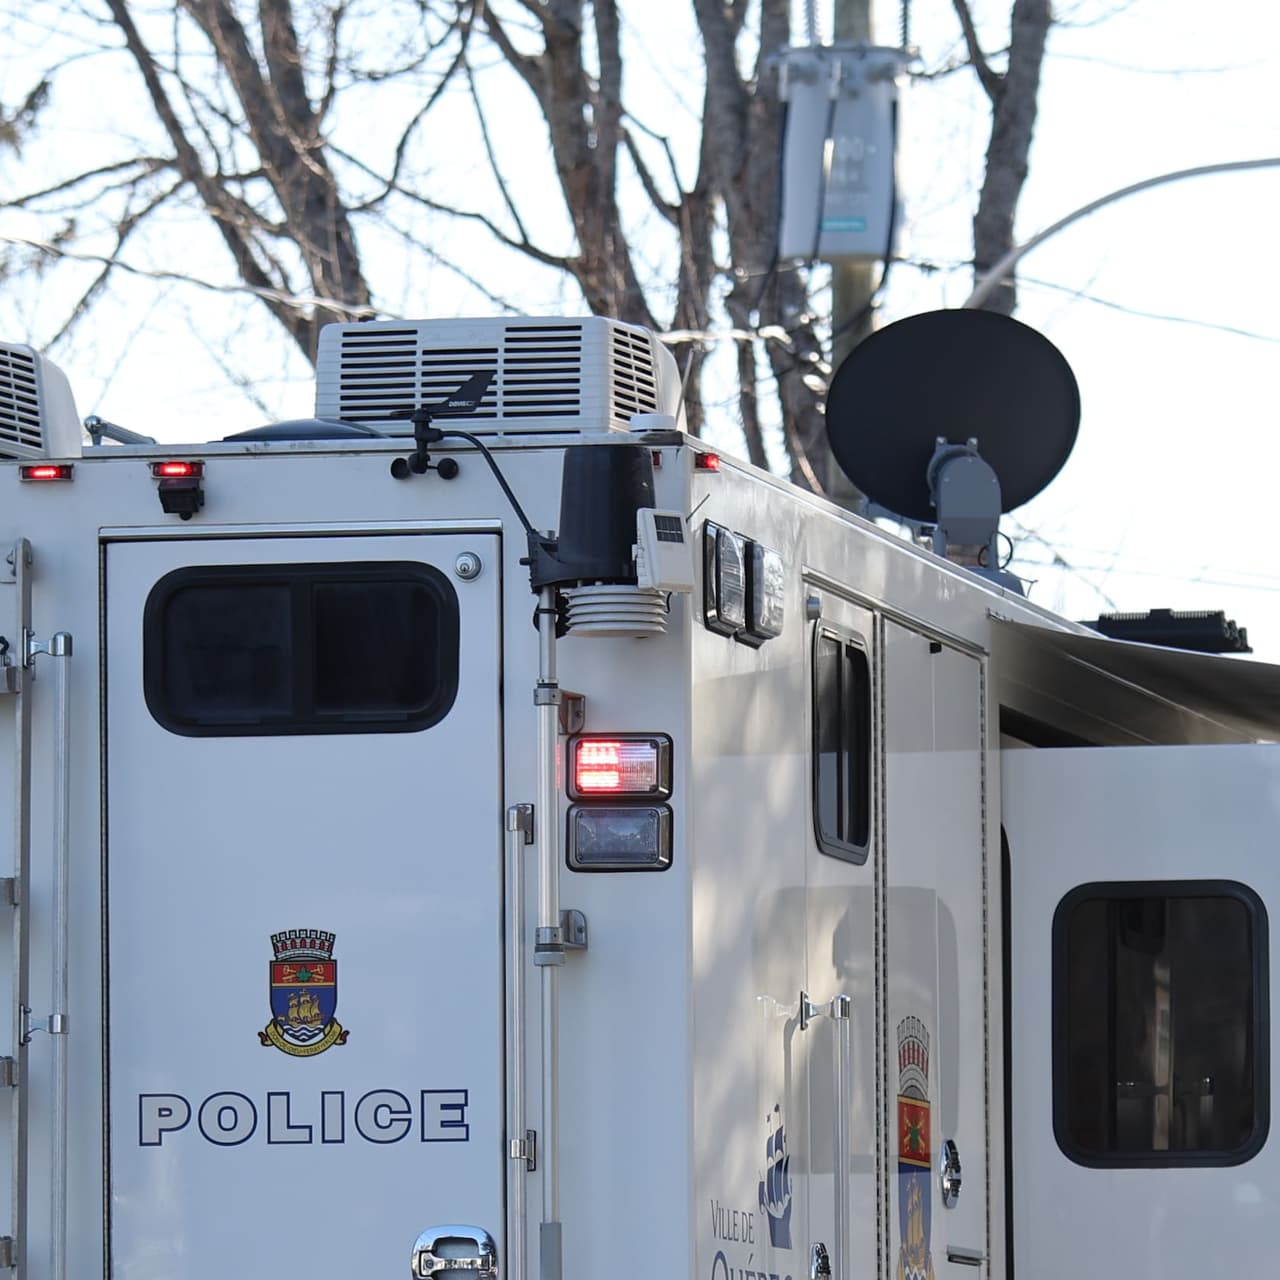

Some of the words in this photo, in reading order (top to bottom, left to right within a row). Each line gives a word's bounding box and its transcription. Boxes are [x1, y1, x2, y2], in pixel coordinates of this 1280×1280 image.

[138, 1088, 470, 1147] POLICE
[710, 1199, 740, 1243] VILLE
[741, 1211, 755, 1245] DE
